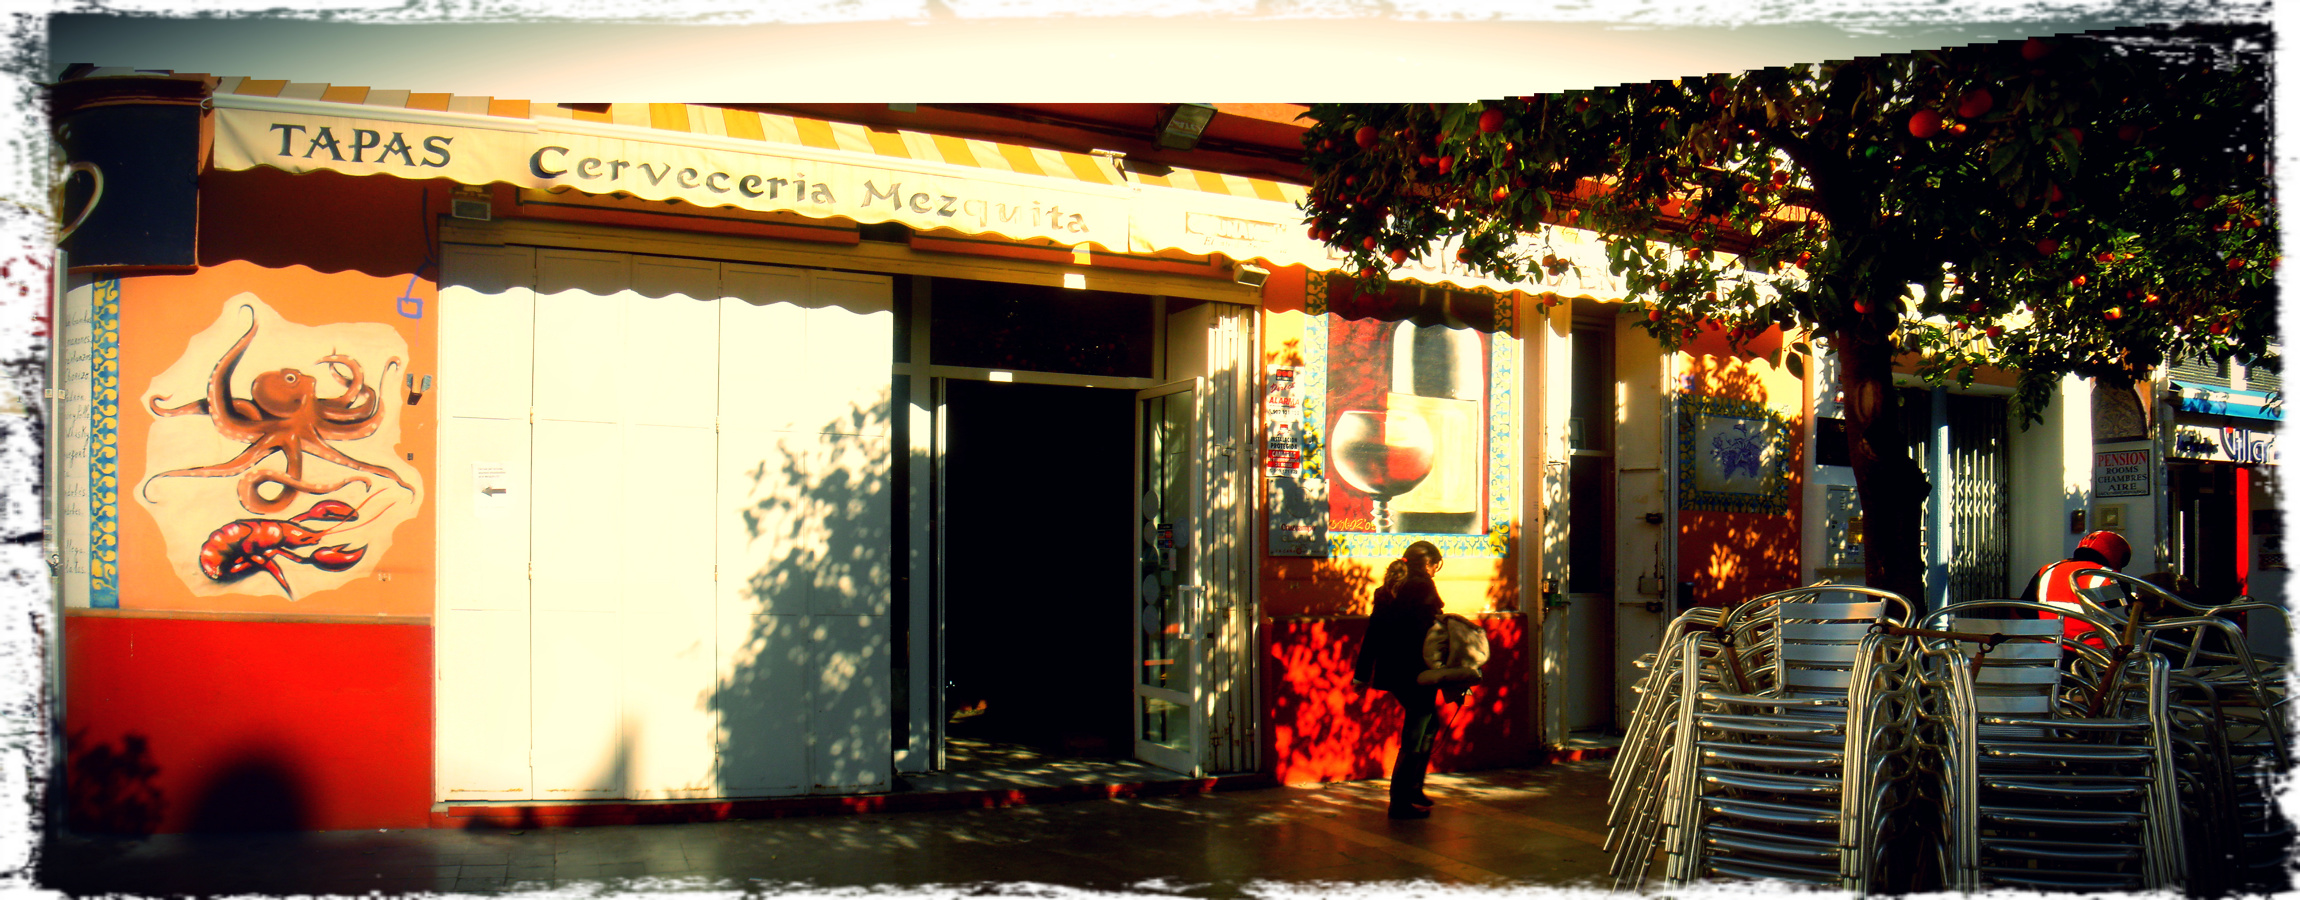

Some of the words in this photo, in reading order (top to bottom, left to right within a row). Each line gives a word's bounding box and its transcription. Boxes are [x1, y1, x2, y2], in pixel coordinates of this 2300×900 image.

[270, 122, 455, 169] TAPAS
[529, 145, 837, 206] Cerveceria
[860, 179, 1090, 235] Mezquita
[1269, 396, 1300, 407] ALARMA
[2097, 451, 2147, 467] PENSION
[2106, 465, 2139, 475] ROOMS
[2097, 473, 2148, 484] CHAMBRES
[2108, 483, 2137, 492] AIRE
